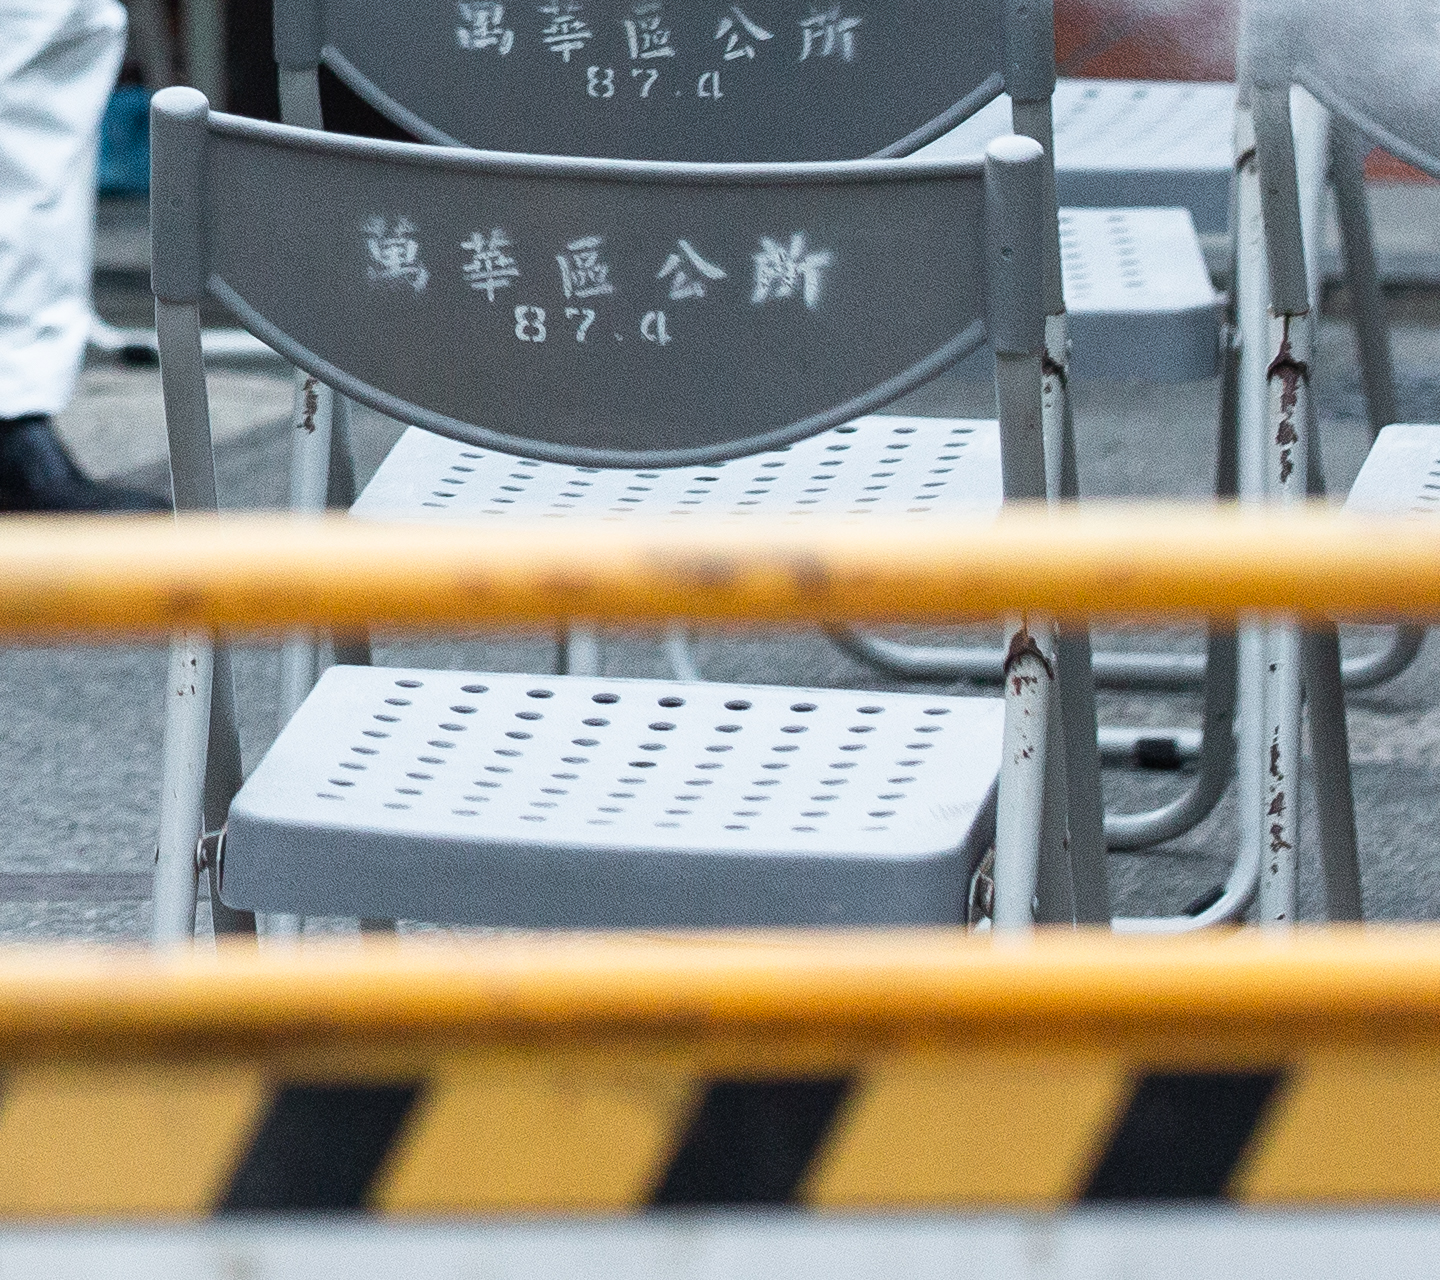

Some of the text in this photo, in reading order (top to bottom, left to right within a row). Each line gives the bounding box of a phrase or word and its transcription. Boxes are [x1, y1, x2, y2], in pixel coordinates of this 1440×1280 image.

[585, 65, 724, 101] 87.4
[360, 218, 832, 310] 萬華區公所
[514, 304, 672, 346] 87.4
